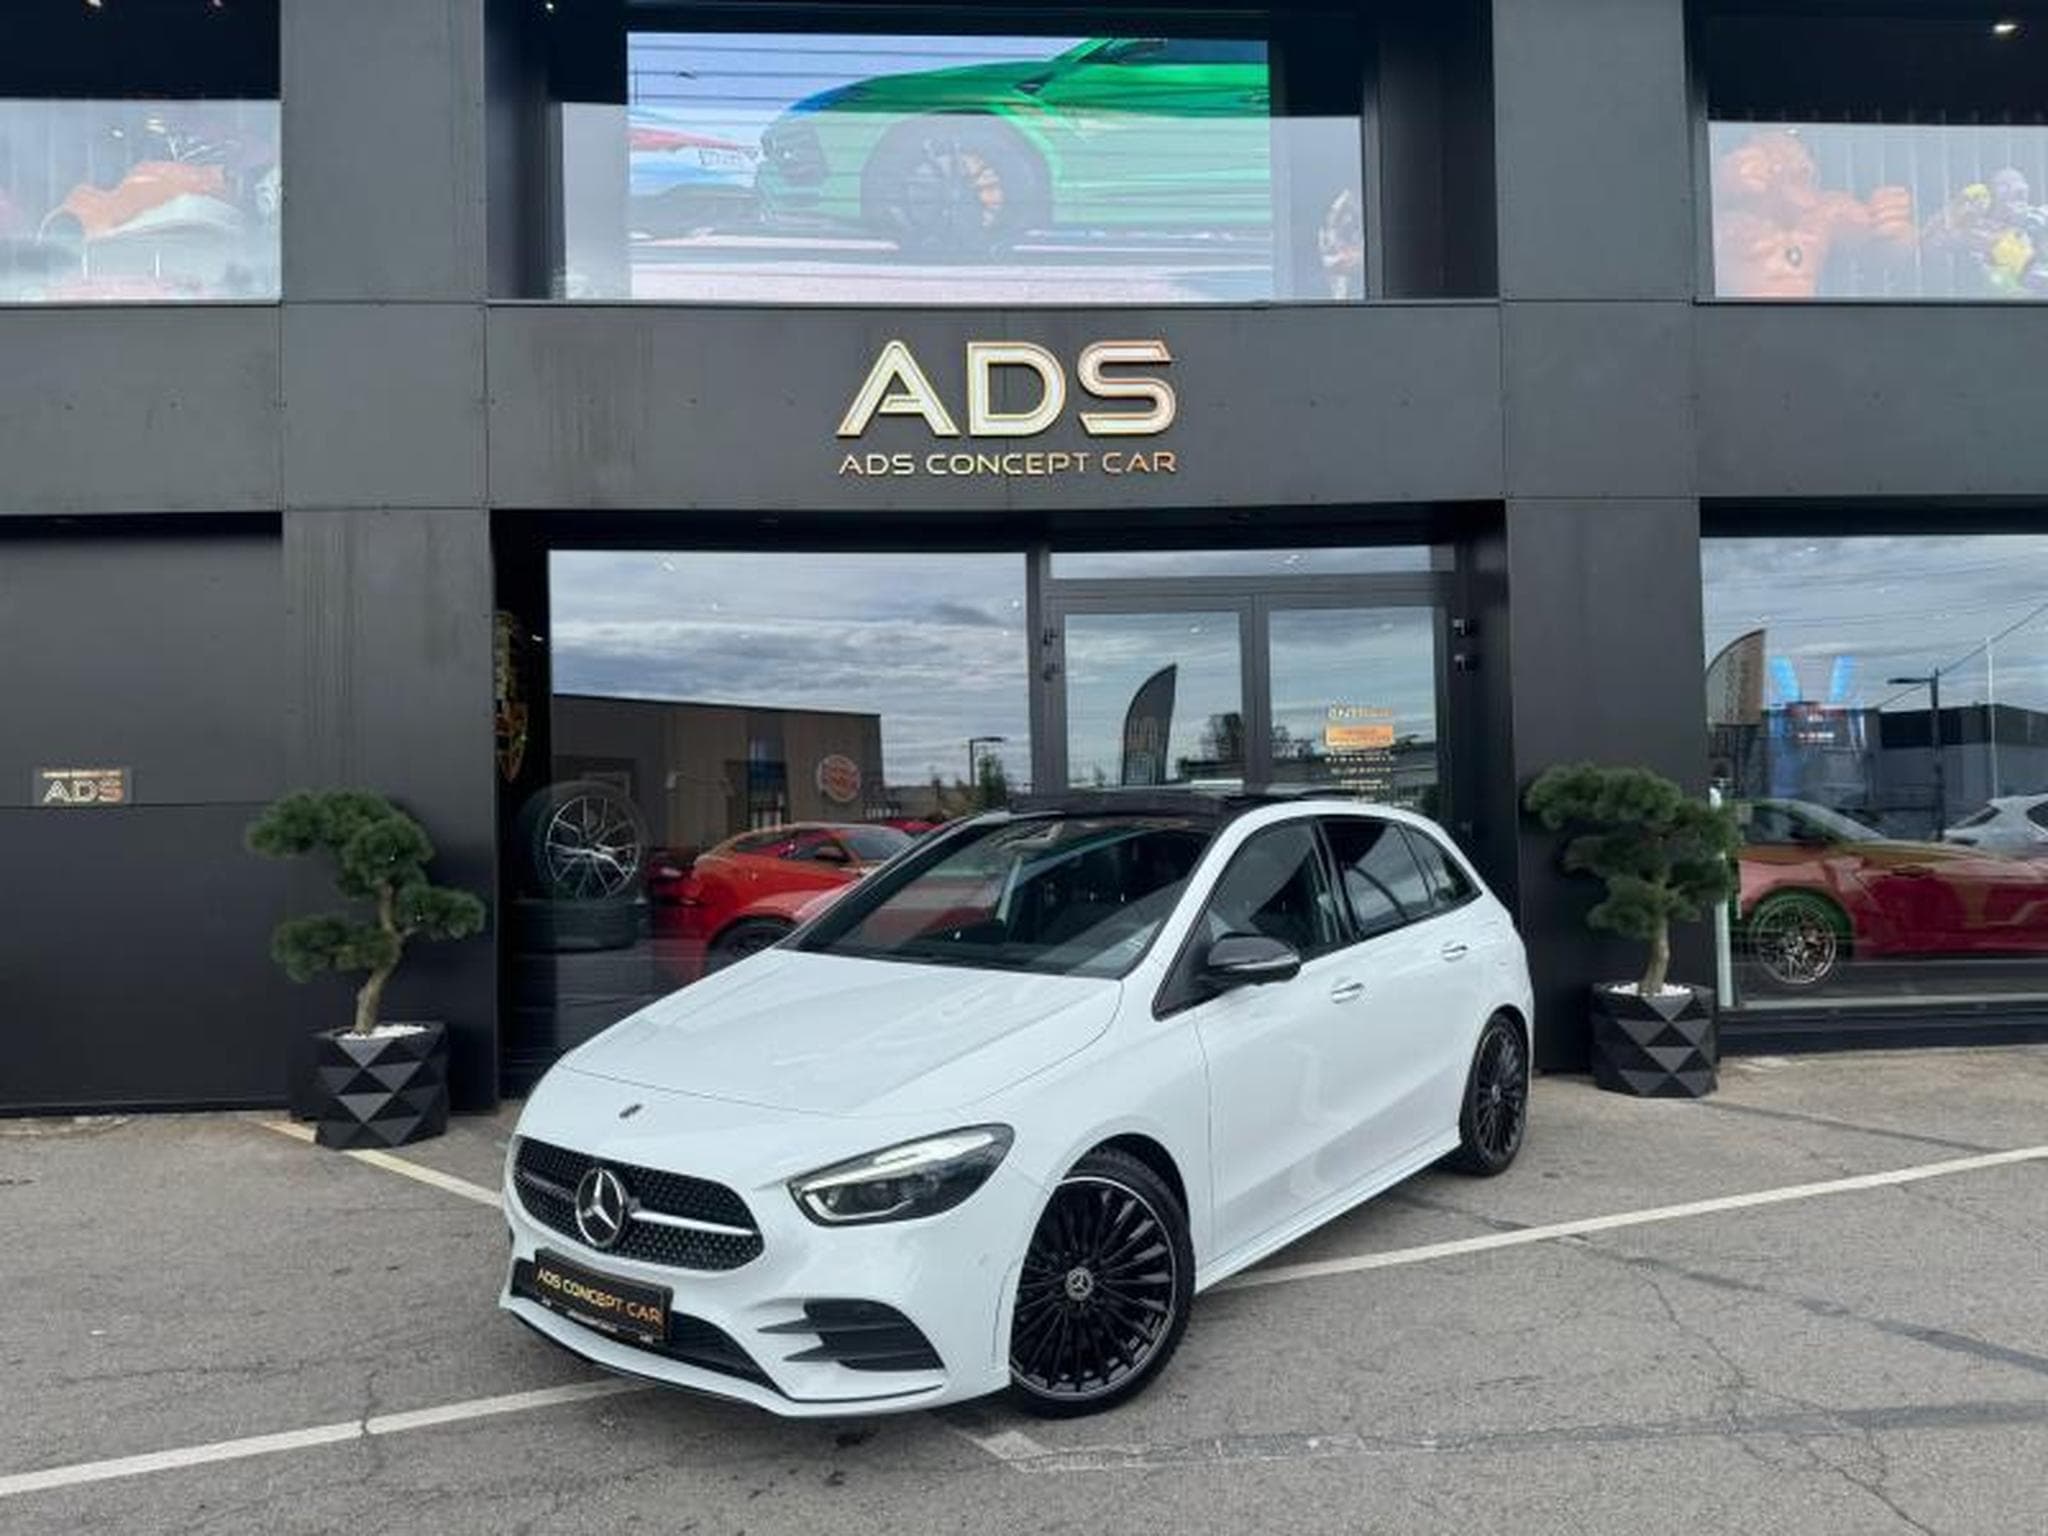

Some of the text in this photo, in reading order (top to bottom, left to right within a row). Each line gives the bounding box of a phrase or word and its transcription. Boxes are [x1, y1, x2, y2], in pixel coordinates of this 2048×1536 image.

[837, 340, 1177, 437] ADS
[839, 452, 1176, 475] ADS CONCEPT CAR
[43, 779, 124, 803] ADS
[537, 1268, 561, 1289] ADS
[563, 1279, 624, 1312] CONCEPT
[626, 1302, 664, 1325] CAR
